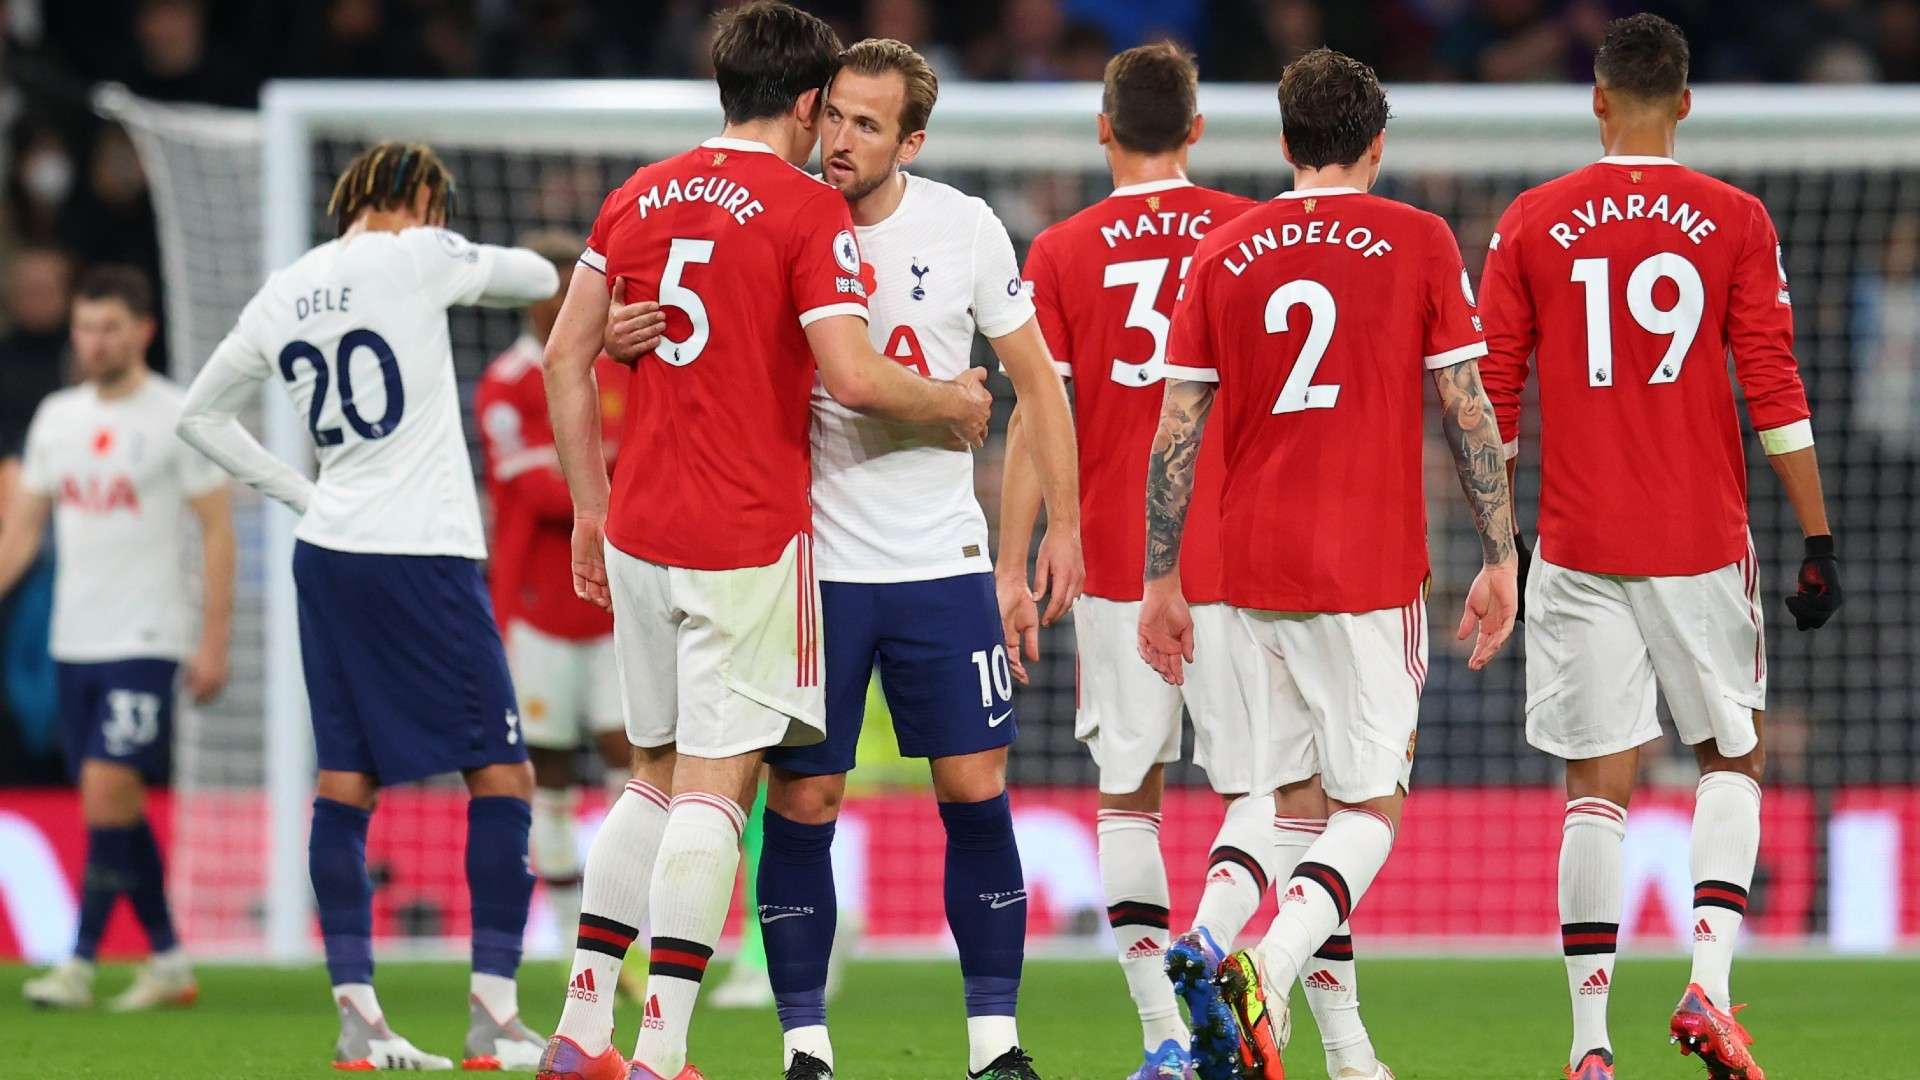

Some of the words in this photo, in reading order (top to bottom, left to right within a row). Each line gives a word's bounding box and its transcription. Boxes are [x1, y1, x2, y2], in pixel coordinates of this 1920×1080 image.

[638, 176, 764, 226] MAGUIRE
[1100, 209, 1212, 249] MATIĆ
[1548, 194, 1717, 250] R.VARANE
[1222, 220, 1393, 277] LINDELOF
[295, 286, 352, 321] DELE
[654, 238, 716, 367] 5
[1103, 255, 1193, 388] 3
[1570, 251, 1705, 388] 19
[1264, 278, 1342, 415] 2
[278, 328, 405, 447] 20
[971, 643, 1013, 708] 10
[1304, 980, 1348, 993] adidas
